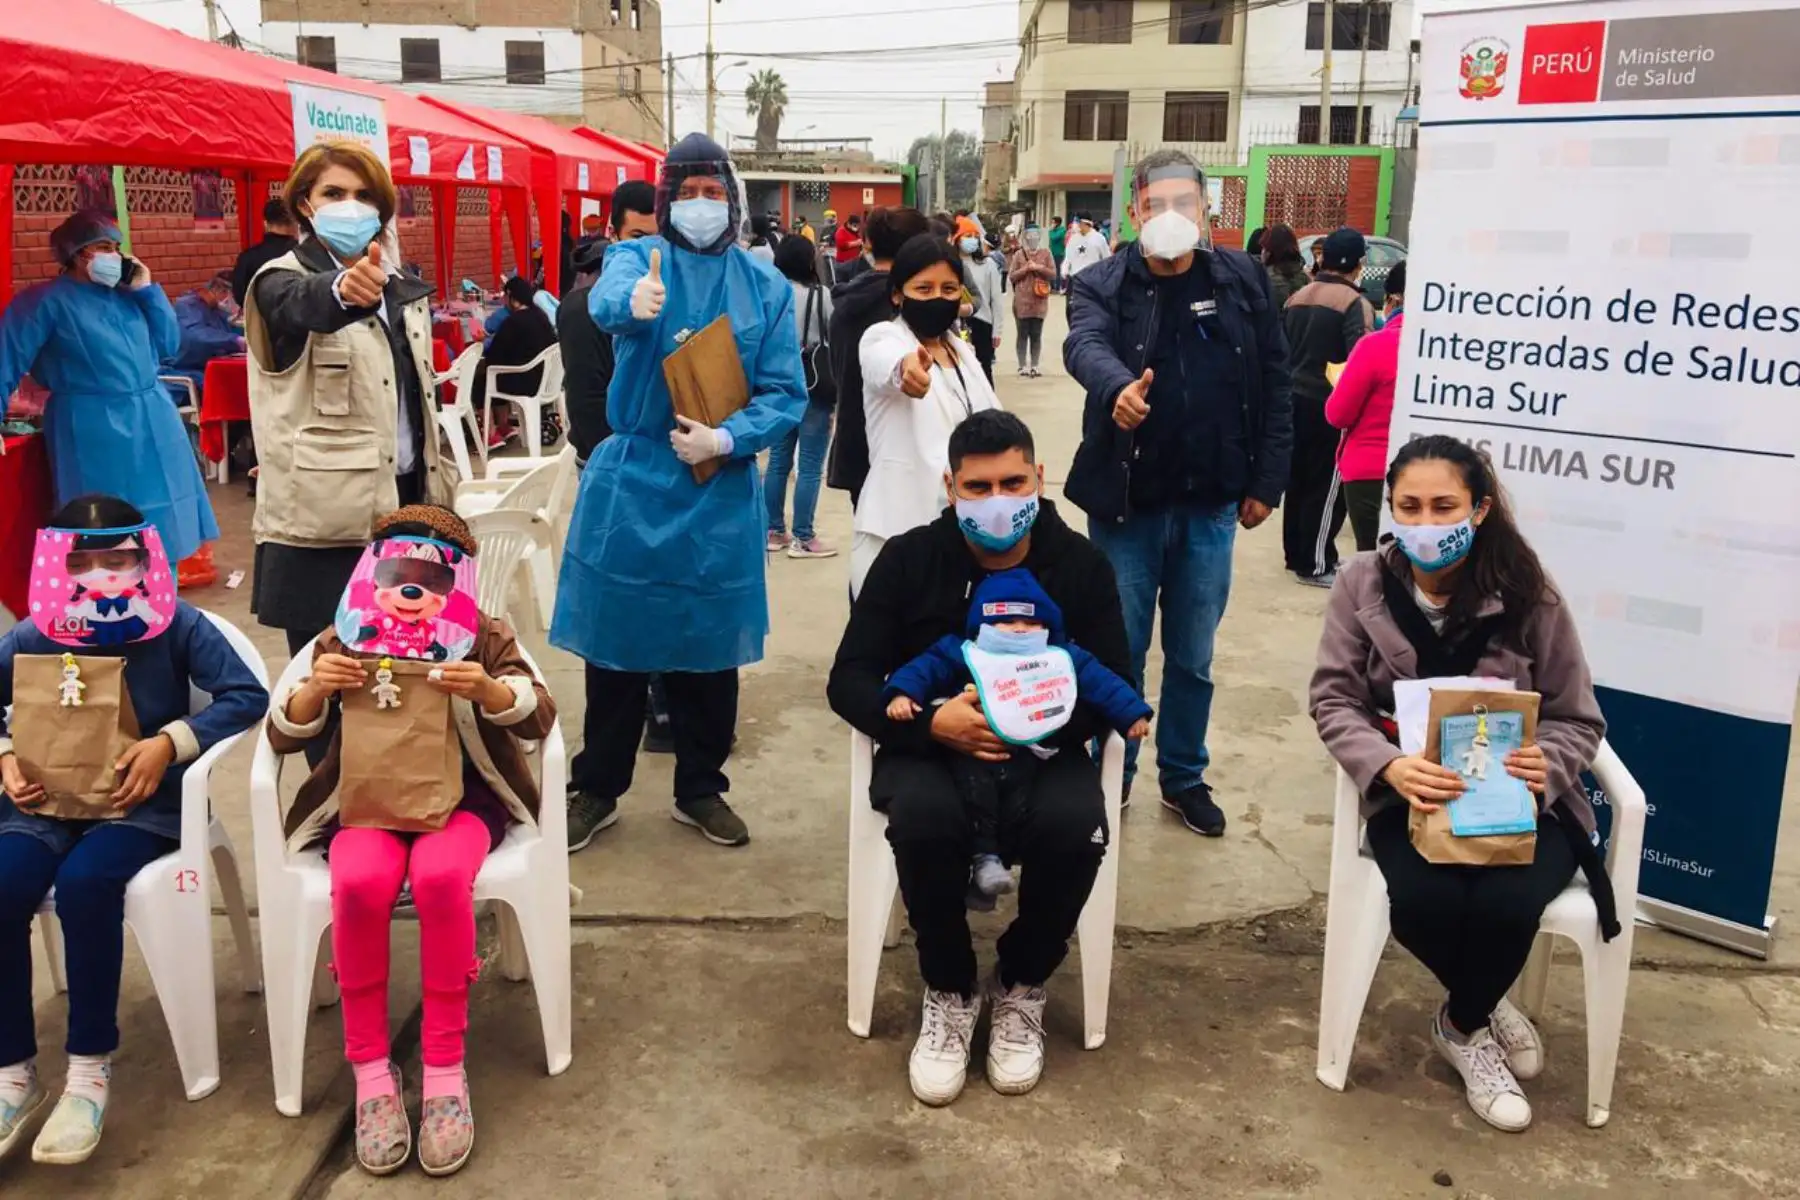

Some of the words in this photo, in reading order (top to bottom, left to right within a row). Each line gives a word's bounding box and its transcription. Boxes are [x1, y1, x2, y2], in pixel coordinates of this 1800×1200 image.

[1532, 47, 1593, 76] PERÚ
[1617, 45, 1715, 65] Ministerio
[1615, 70, 1638, 87] de
[1643, 67, 1696, 86] Salud
[306, 101, 377, 135] Vacúnate
[1423, 282, 1591, 321] Dirección
[1606, 288, 1657, 324] de
[1671, 293, 1800, 333] Redes
[1418, 328, 1610, 371] Integradas
[1624, 340, 1674, 376] de
[1413, 373, 1496, 410] Lima
[1507, 381, 1567, 416] Sur
[1502, 442, 1589, 480] LIMA
[1600, 453, 1676, 490] SUR
[175, 870, 199, 893] 13
